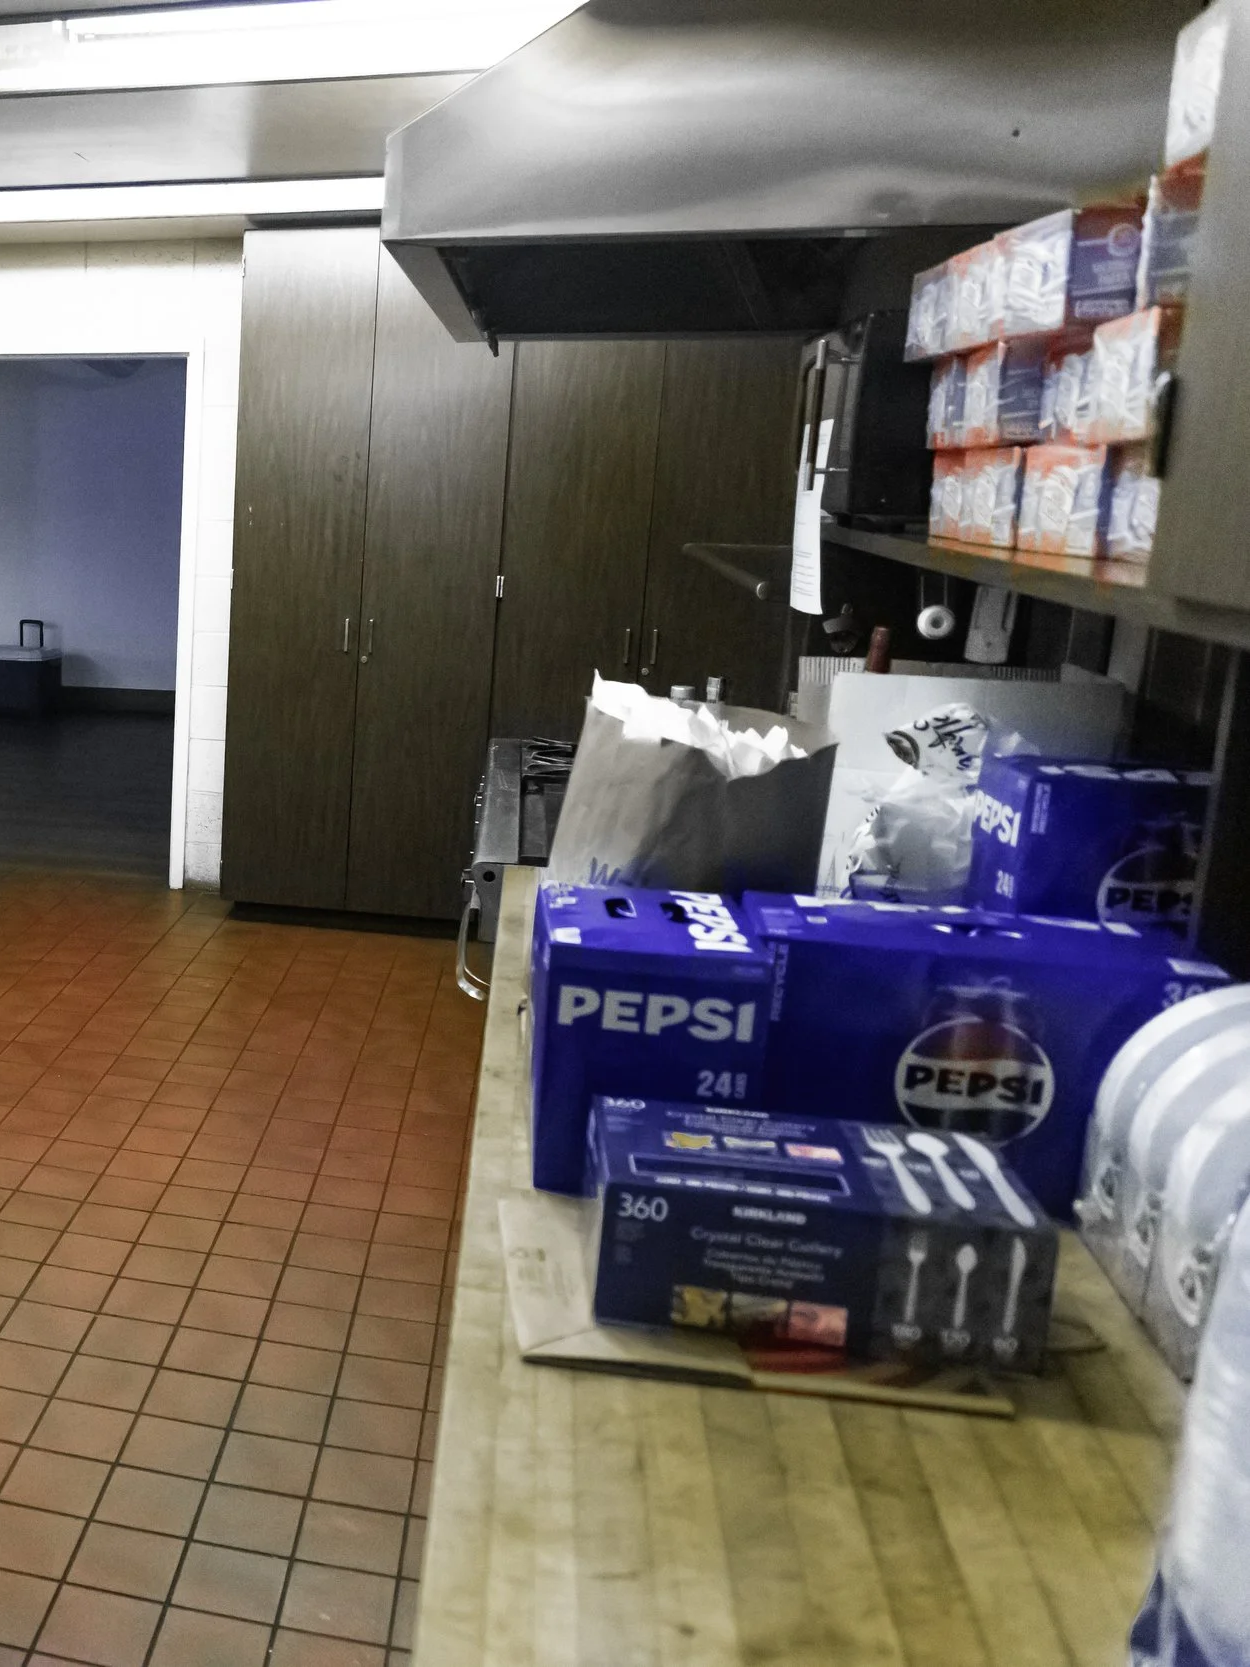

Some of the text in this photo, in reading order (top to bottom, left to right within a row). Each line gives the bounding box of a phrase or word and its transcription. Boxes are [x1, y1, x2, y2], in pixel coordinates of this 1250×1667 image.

[973, 789, 1021, 848] PEPSI
[669, 890, 754, 953] PEPSI
[557, 984, 756, 1043] PEPSI
[696, 1069, 732, 1099] 24
[903, 1064, 1045, 1105] PEPSI
[617, 1191, 670, 1223] 360
